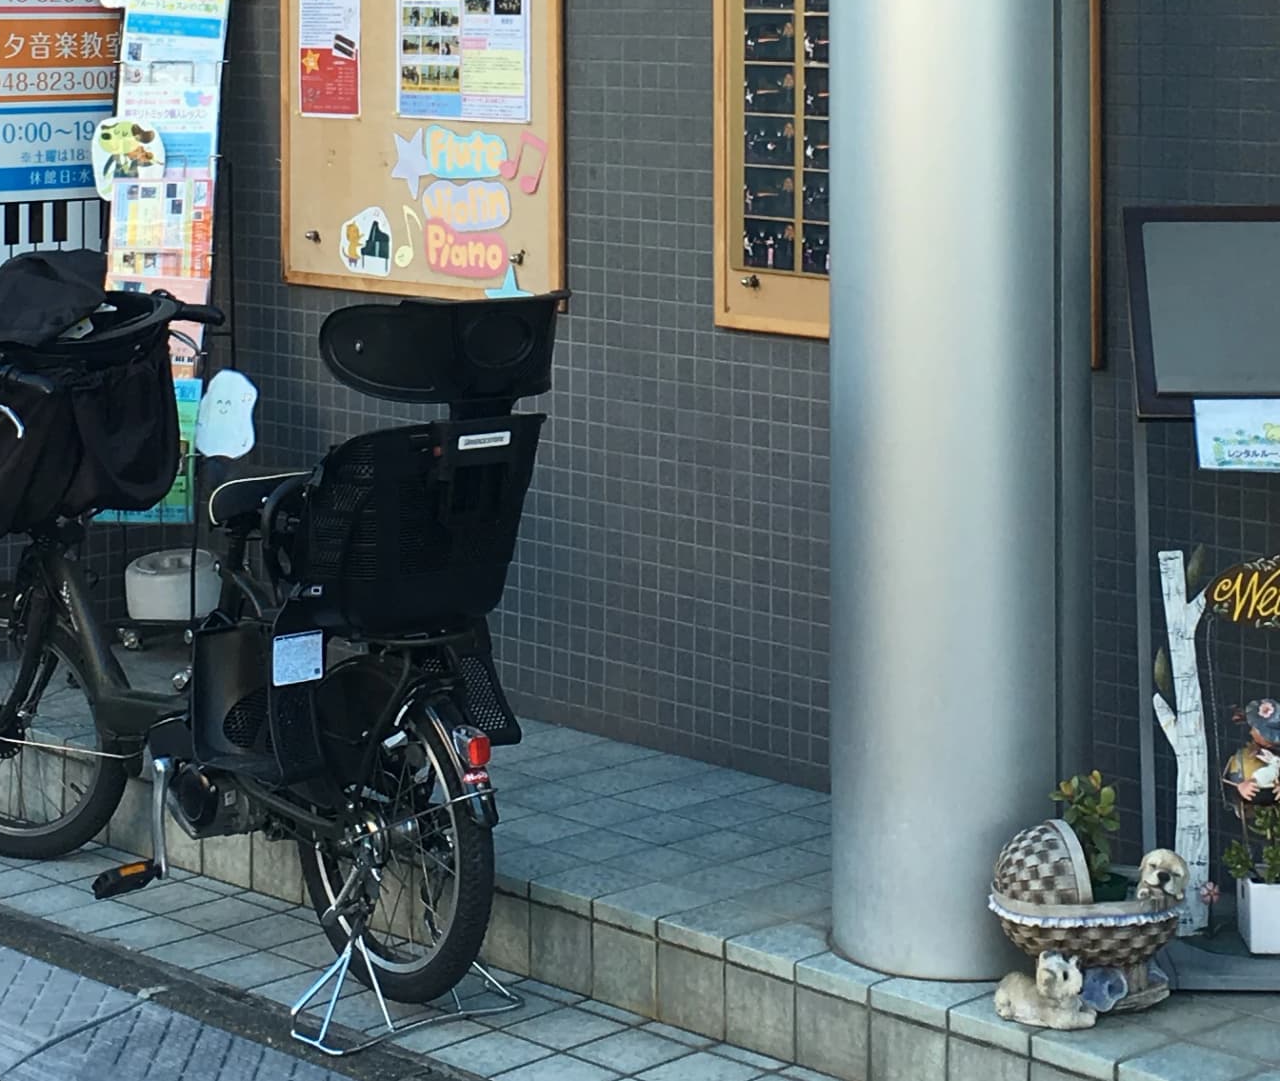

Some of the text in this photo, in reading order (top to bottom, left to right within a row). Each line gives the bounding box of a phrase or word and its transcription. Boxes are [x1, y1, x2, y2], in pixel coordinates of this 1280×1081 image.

[21, 149, 89, 163] ※土曜は18:
[430, 130, 502, 172] Flute
[30, 169, 90, 185] 休館日:水
[424, 186, 508, 224] Violin
[427, 224, 503, 270] Piano
